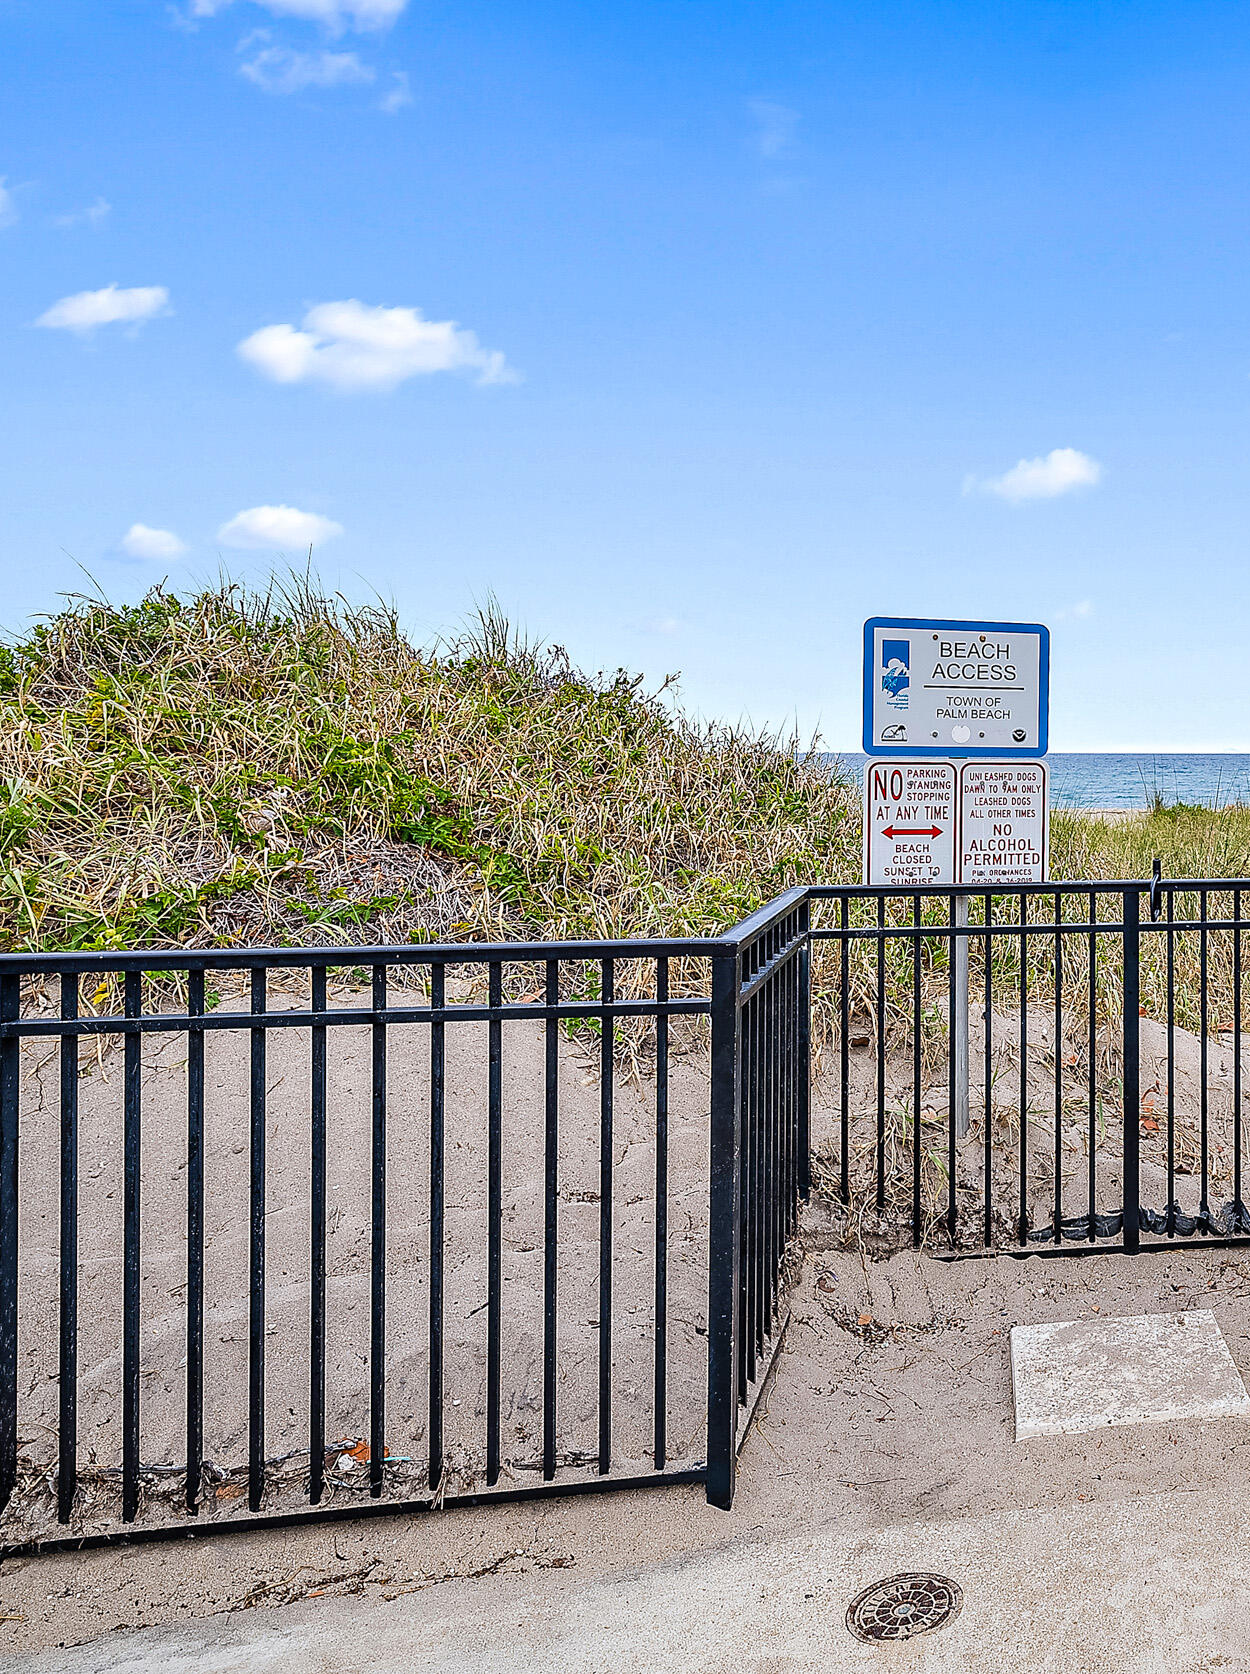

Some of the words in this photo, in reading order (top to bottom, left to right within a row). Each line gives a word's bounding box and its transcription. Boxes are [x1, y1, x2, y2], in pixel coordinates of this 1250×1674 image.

[940, 642, 1010, 660] BEACH
[932, 663, 1017, 681] ACCESS
[946, 696, 982, 707] TOWN
[985, 697, 1002, 707] OF
[936, 709, 968, 719] PALM
[971, 710, 1011, 720] BEACH
[907, 769, 946, 778] PARKING
[969, 772, 1013, 781] UNLEASHED
[1016, 772, 1037, 781] DOGS
[874, 769, 904, 801] NO
[907, 780, 951, 790] STANDING
[964, 784, 986, 794] DAWN
[989, 785, 998, 793] TO
[1021, 784, 1041, 793] ONLY
[907, 792, 950, 801] STOPPING
[974, 797, 1008, 806] LEASHED
[1011, 797, 1032, 806] DOGS
[876, 806, 891, 820] AT
[896, 805, 919, 820] ANY
[925, 805, 949, 820] TIME
[969, 809, 985, 819] ALL
[987, 809, 1012, 818] OTHER
[1015, 809, 1036, 818] TIMES
[993, 824, 1012, 836] NO
[895, 844, 930, 853] BEACH
[969, 839, 1035, 851] ALCOHOL
[892, 855, 932, 864] CLOSED
[964, 853, 1040, 866] PERMITTED
[884, 867, 923, 877] SUNSET
[928, 866, 941, 876] TO
[862, 1584, 906, 1616] TYLER
